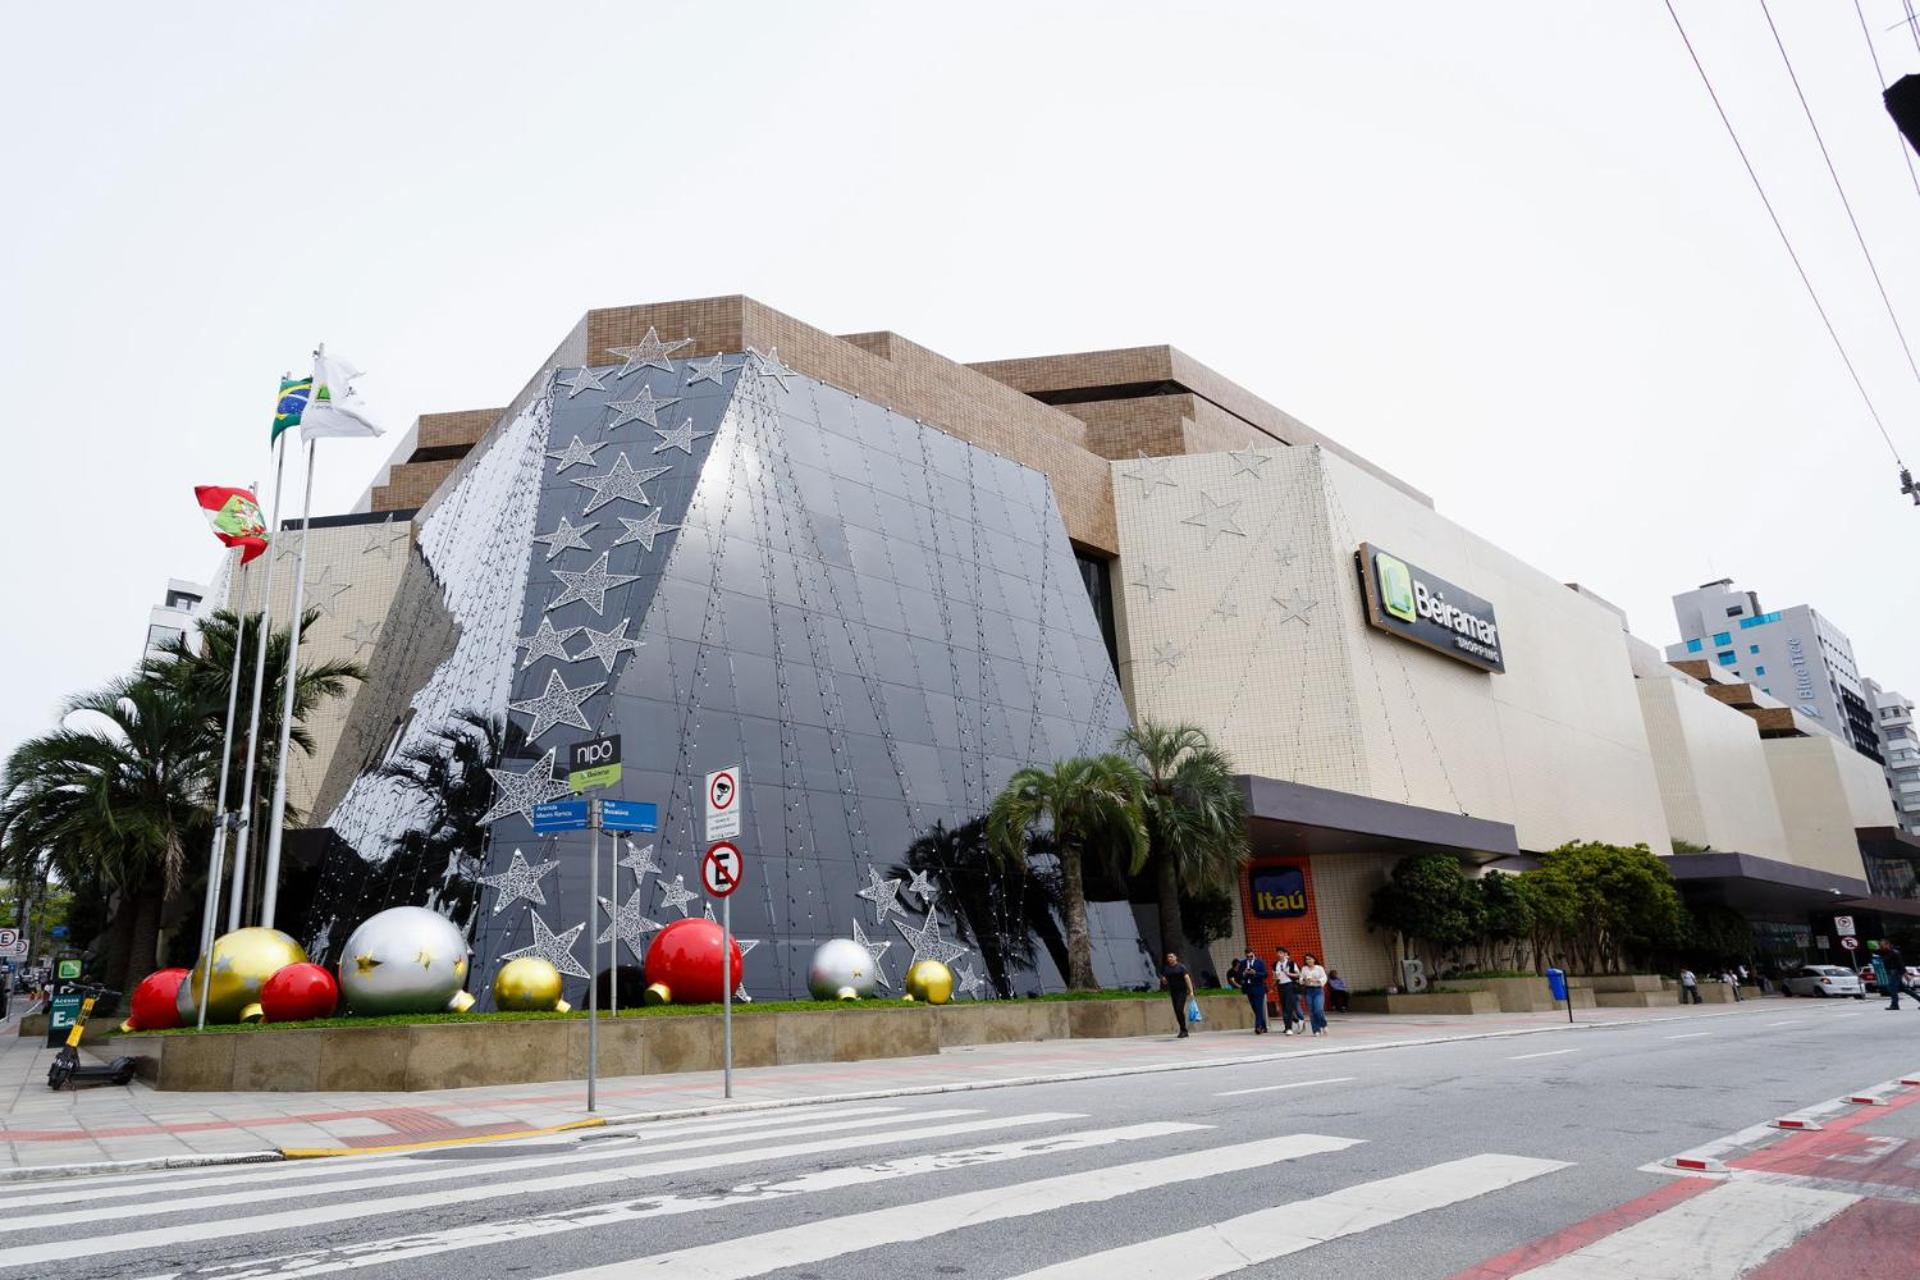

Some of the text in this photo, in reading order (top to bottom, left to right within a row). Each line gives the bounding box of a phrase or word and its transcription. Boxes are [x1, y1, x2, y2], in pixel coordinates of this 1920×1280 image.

[1413, 579, 1497, 646] Beiramar
[1454, 636, 1500, 662] SHOPPING
[715, 853, 730, 885] E
[1257, 890, 1305, 911] Itaú
[1, 933, 10, 944] E
[53, 1011, 66, 1027] E
